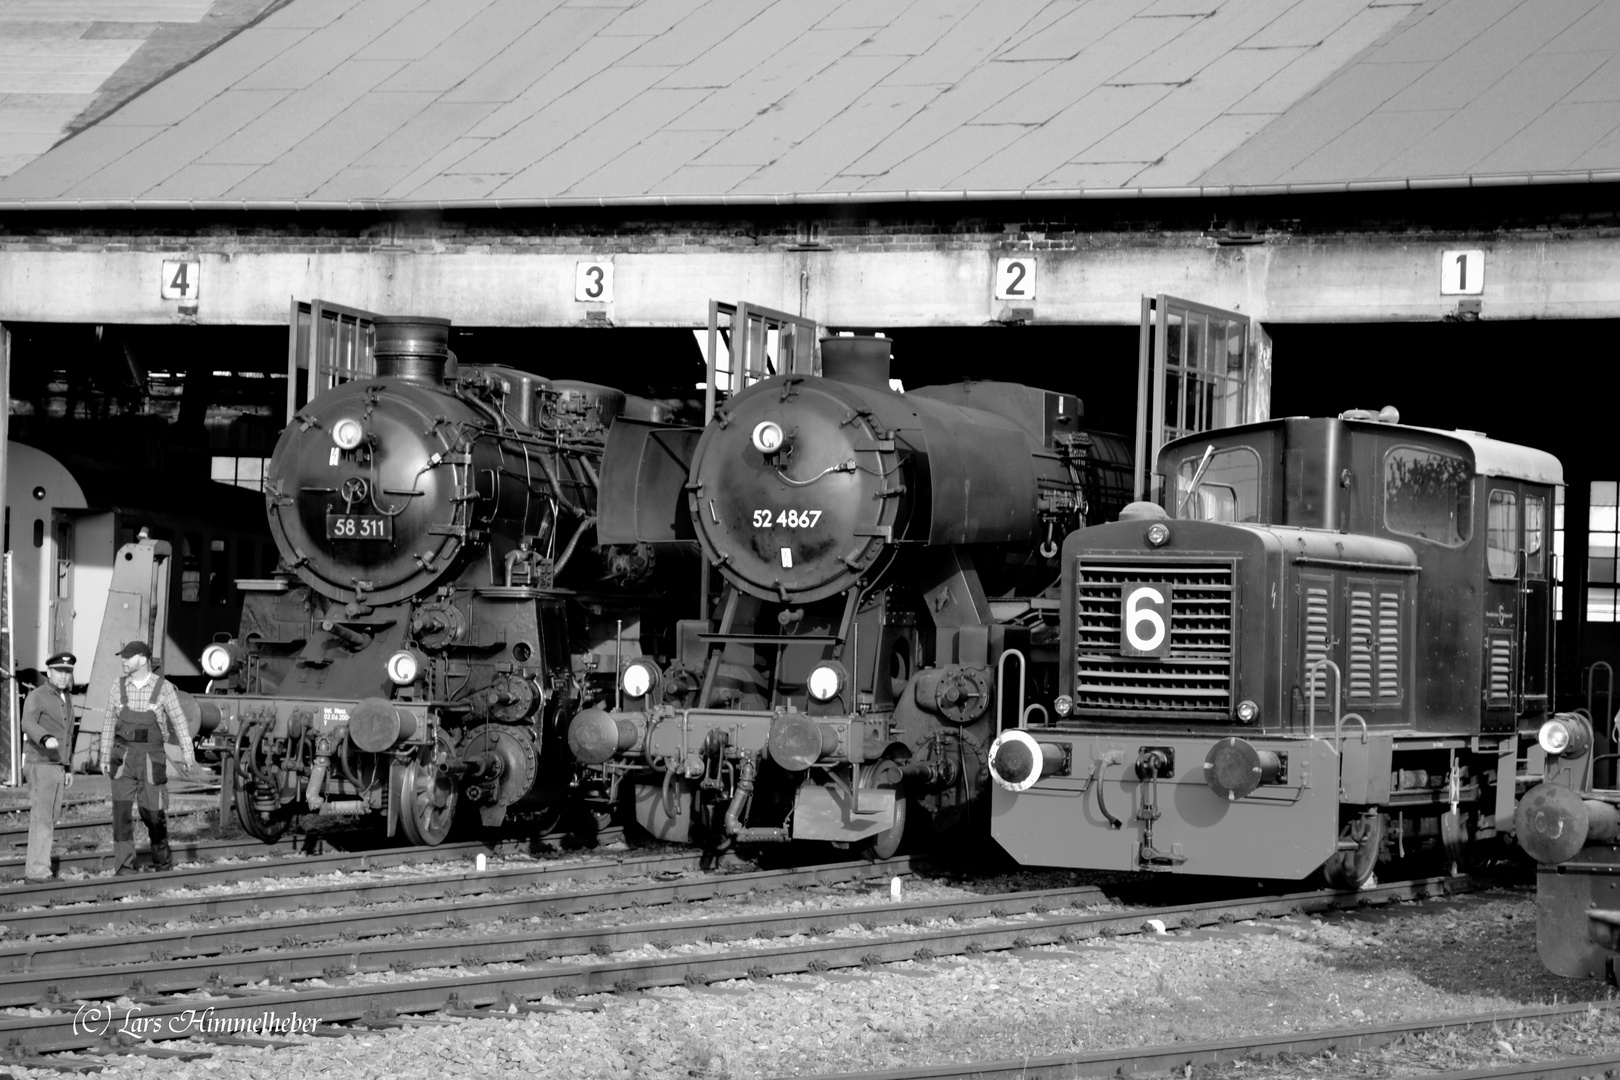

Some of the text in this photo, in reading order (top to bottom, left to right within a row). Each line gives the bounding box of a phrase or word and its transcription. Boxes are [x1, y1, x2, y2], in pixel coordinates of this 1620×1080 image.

[170, 264, 190, 296] 4
[585, 266, 604, 297] 3
[1005, 262, 1026, 295] 2
[1456, 254, 1468, 290] 1
[334, 518, 384, 537] 58 311
[752, 509, 823, 528] 52 4867
[1126, 587, 1166, 651] 6
[323, 713, 350, 721] 02.06.200
